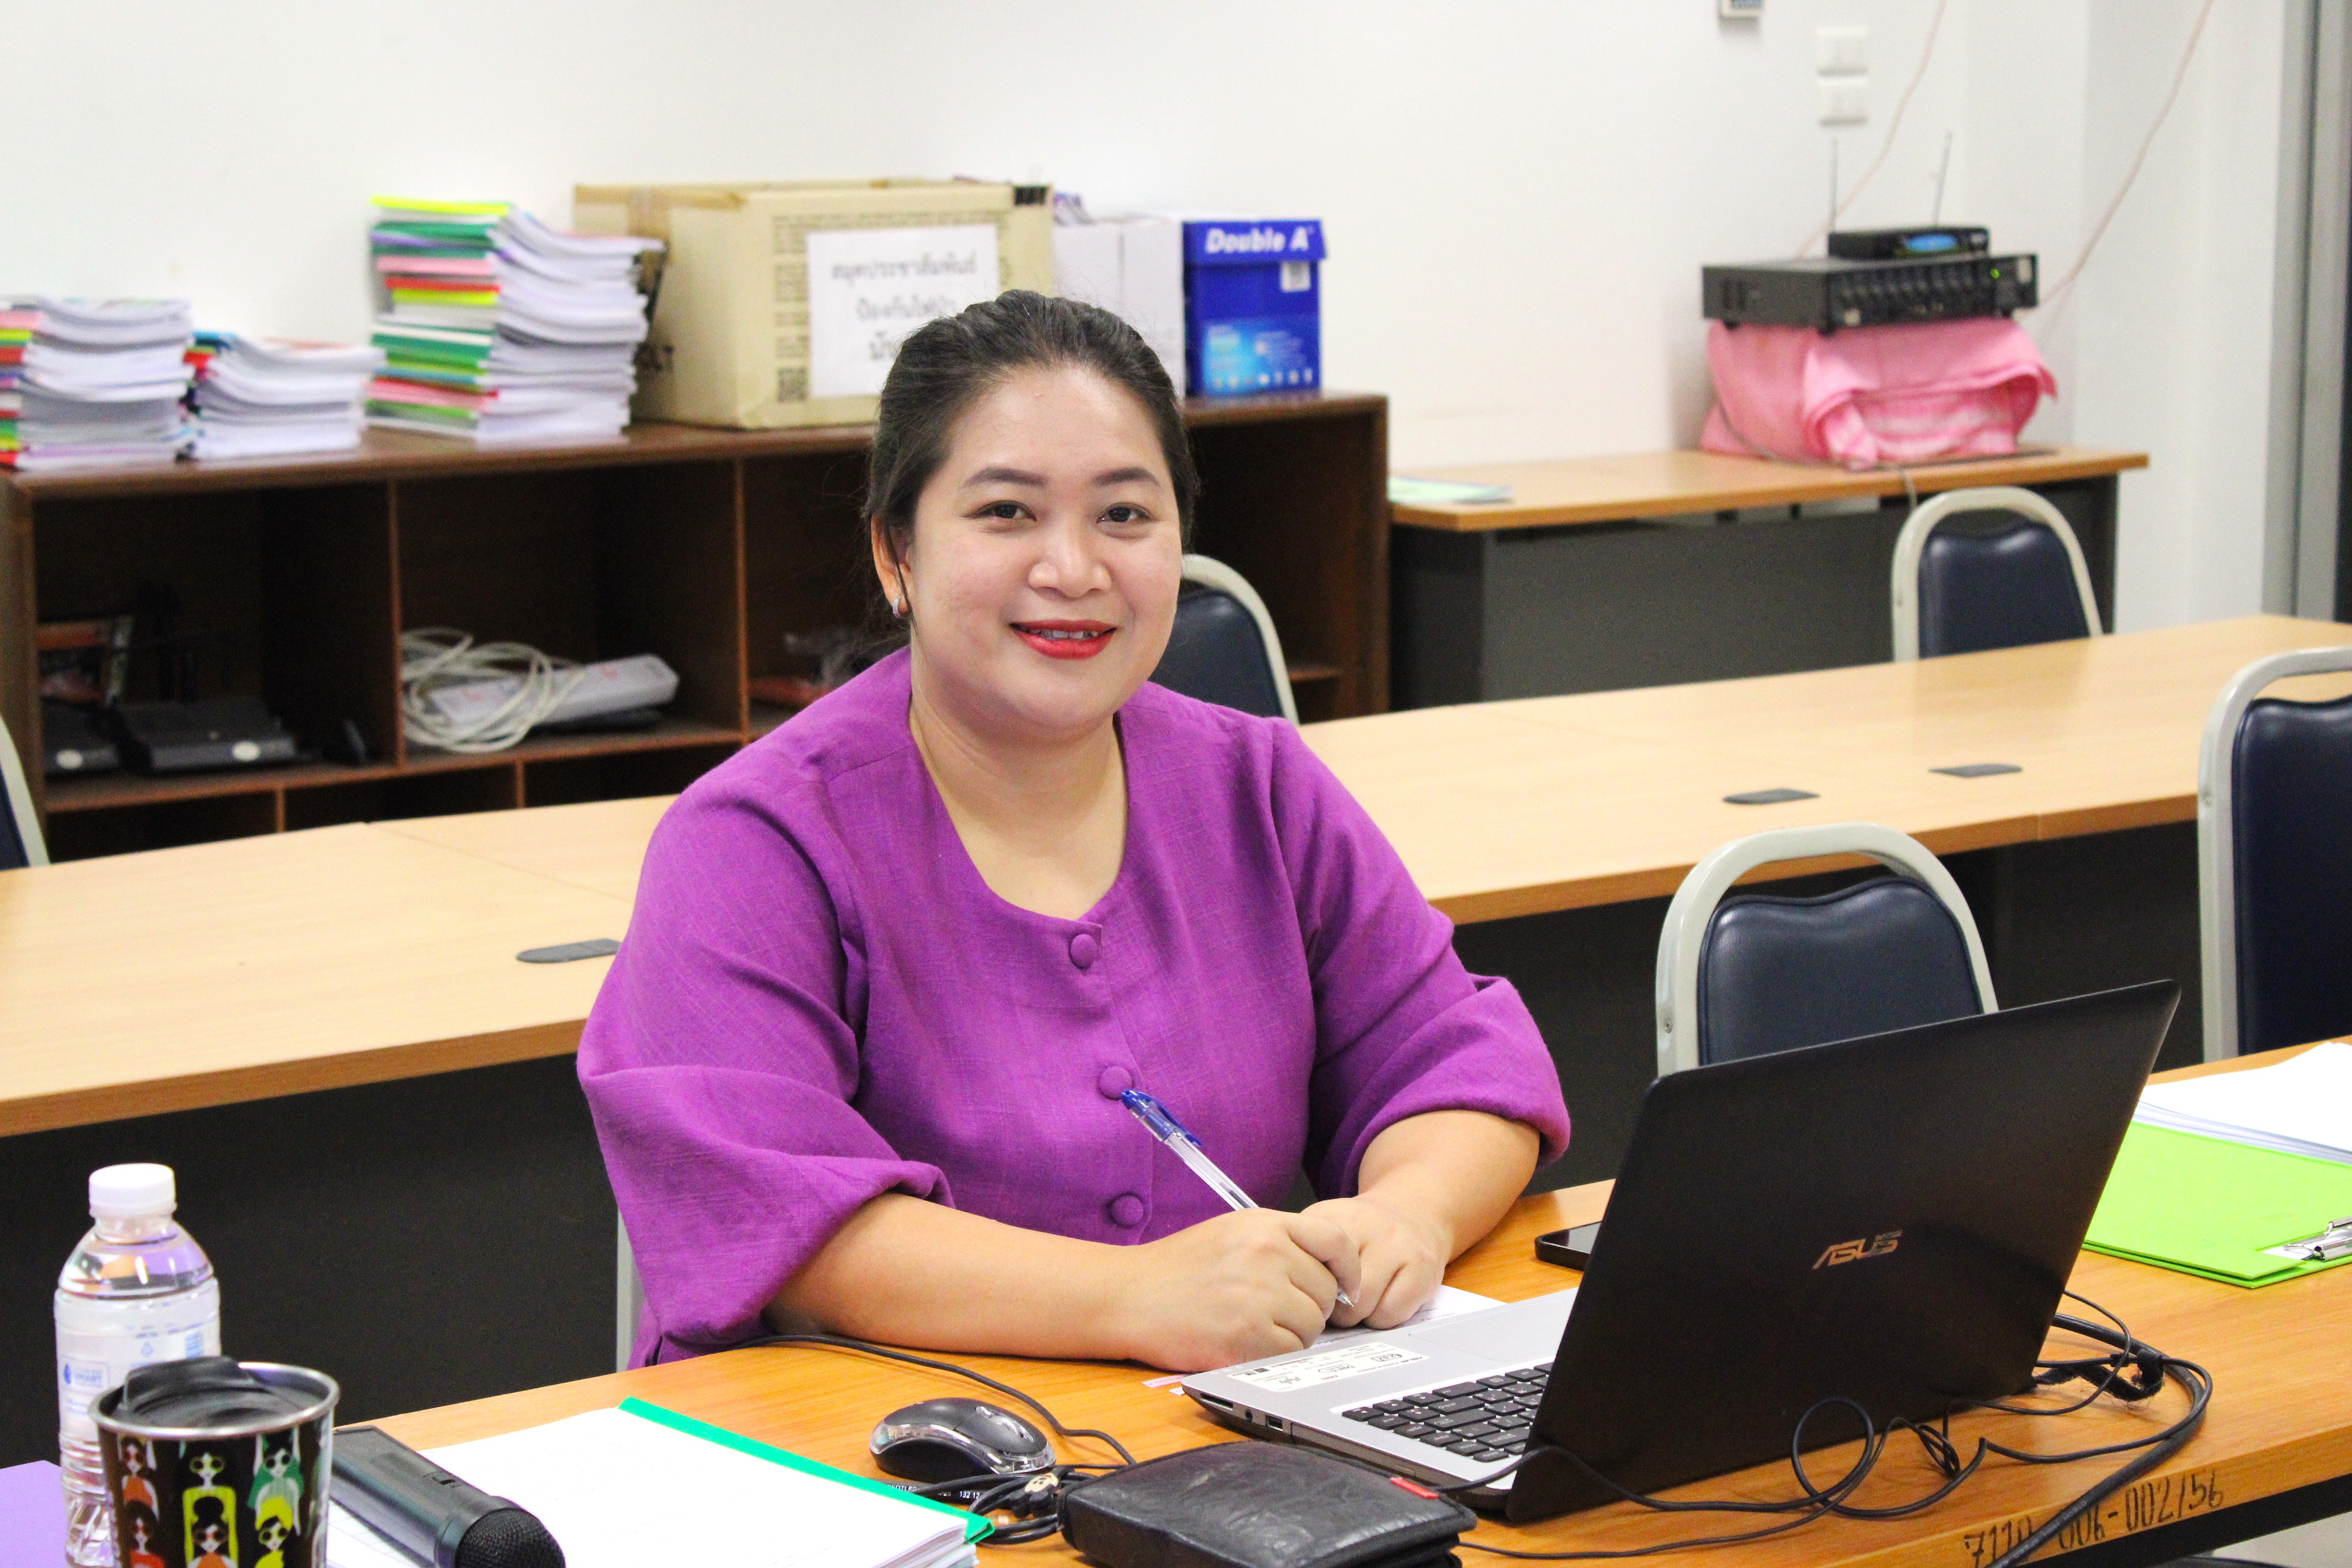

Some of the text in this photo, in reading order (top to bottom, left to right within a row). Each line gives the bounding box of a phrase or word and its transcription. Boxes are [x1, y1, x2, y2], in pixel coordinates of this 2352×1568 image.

[1206, 227, 1309, 254] Double A
[1812, 1230, 1903, 1270] ASUS
